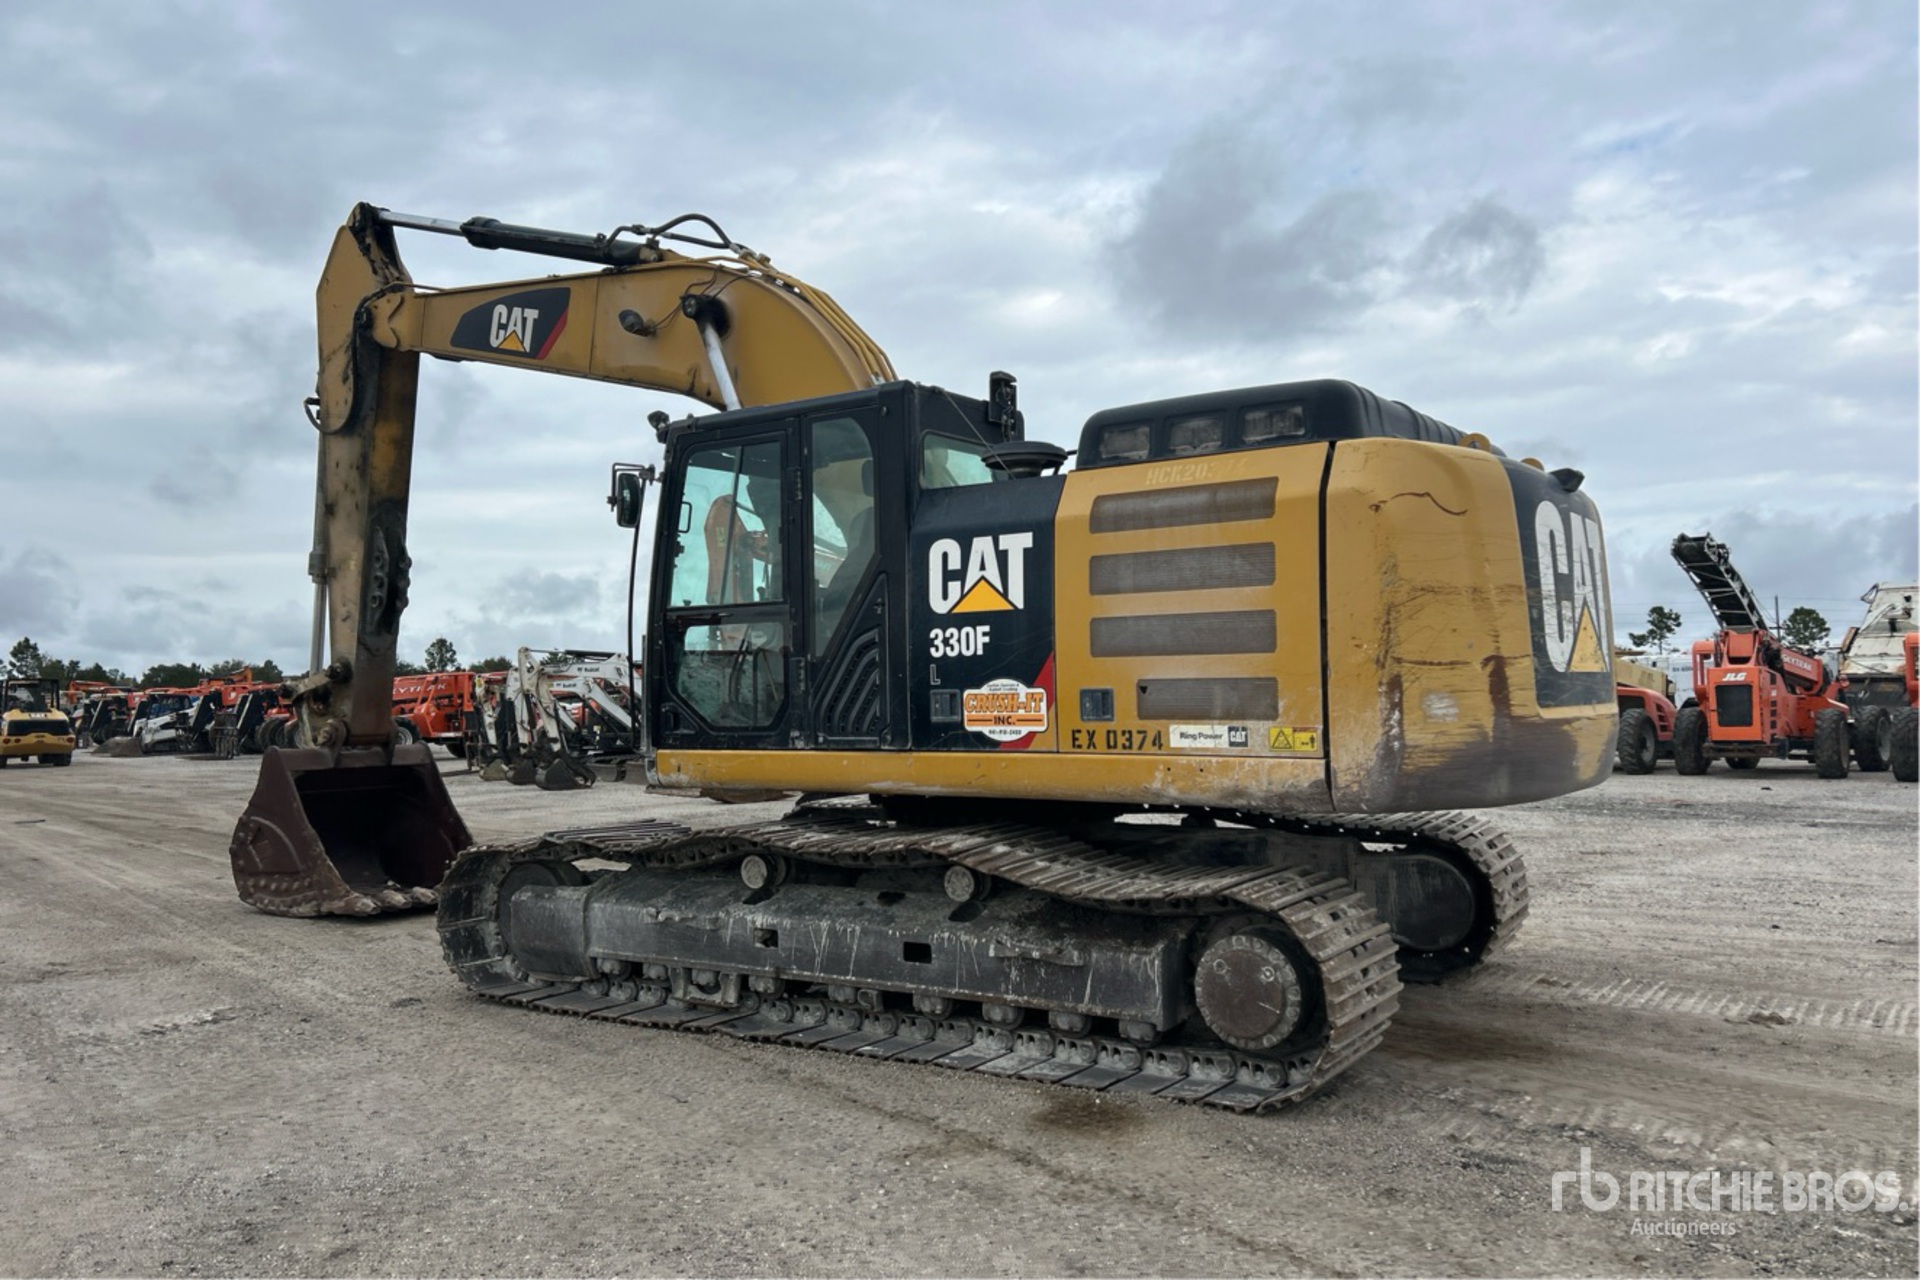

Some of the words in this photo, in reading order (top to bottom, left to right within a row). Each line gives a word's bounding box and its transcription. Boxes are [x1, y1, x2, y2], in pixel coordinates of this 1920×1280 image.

[489, 304, 540, 353] CAT
[928, 532, 1034, 615] CAT
[1534, 500, 1609, 672] CAT
[929, 625, 991, 658] 330F
[930, 664, 941, 686] L
[1722, 672, 1747, 682] JLG
[964, 692, 1044, 714] CRUSH-IT
[993, 716, 1016, 726] INC.
[1071, 729, 1097, 750] EX
[1106, 729, 1164, 750] 0374
[1179, 732, 1198, 742] Ring
[1198, 732, 1224, 741] Power
[1230, 729, 1247, 743] CAT
